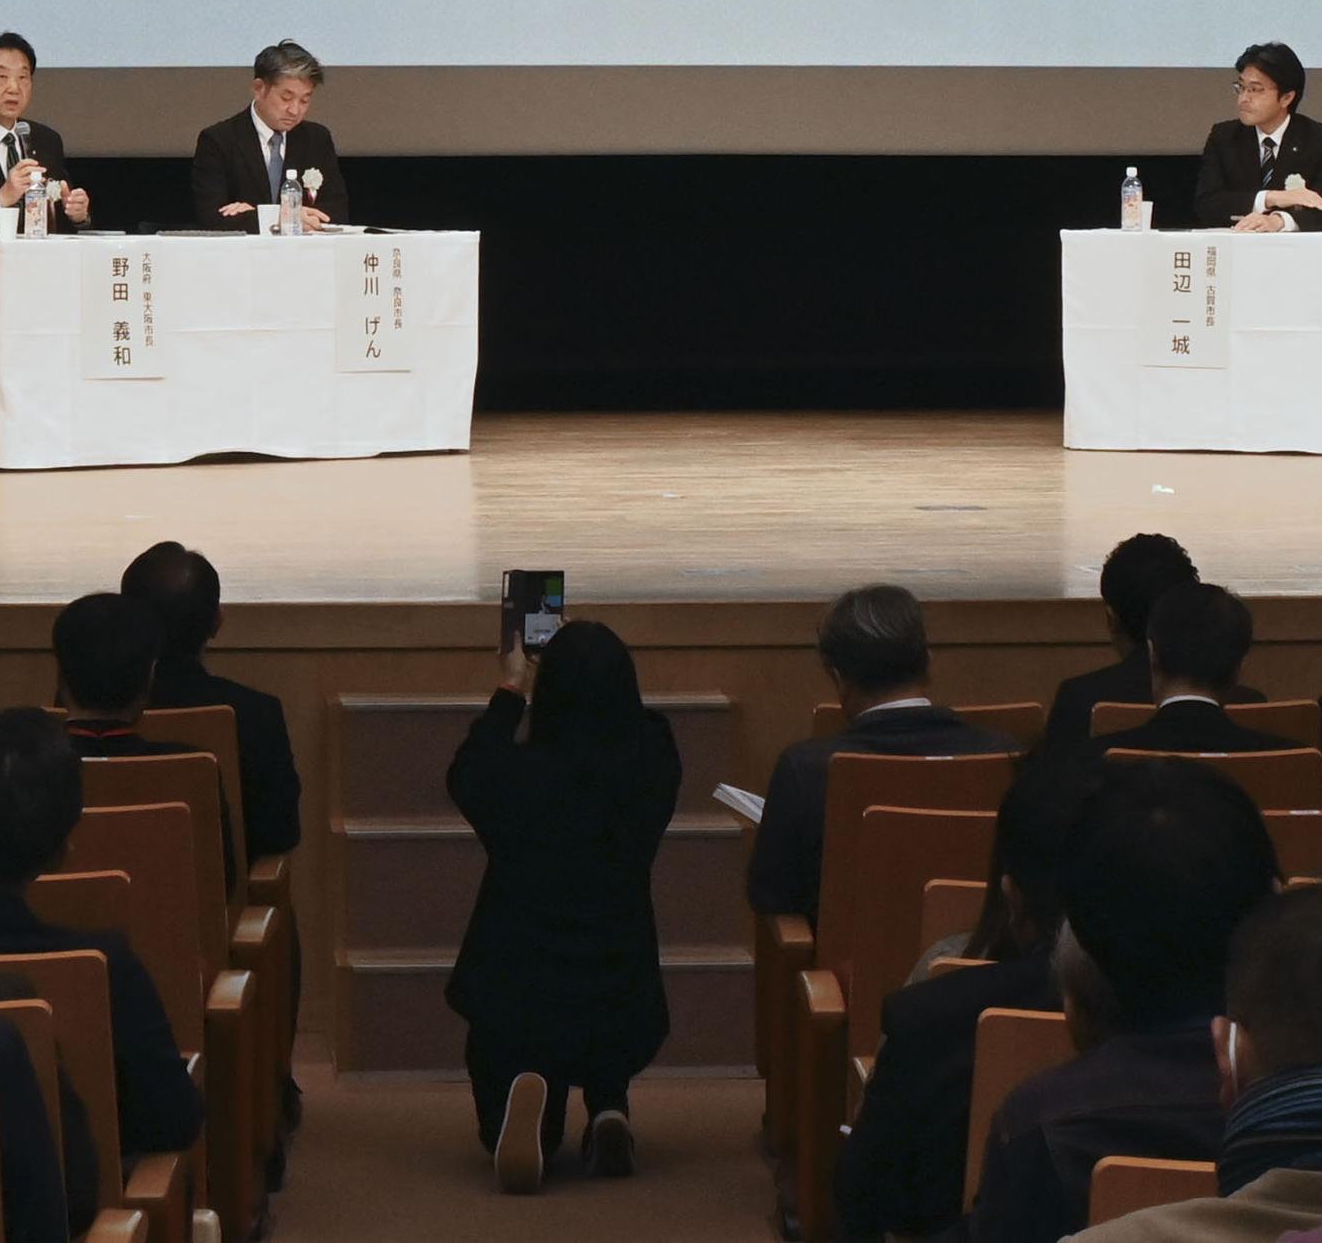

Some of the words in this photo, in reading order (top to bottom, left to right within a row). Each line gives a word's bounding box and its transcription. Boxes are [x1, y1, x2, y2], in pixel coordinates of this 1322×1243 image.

[112, 257, 130, 302] 野田
[141, 252, 152, 285] 大阪府
[362, 253, 379, 296] 仲川
[1172, 251, 1192, 293] 田辺
[1205, 246, 1217, 278] 福岡県
[142, 291, 154, 347] 東大阪市長
[365, 316, 382, 359] げん
[1171, 319, 1191, 355] 一城
[112, 320, 132, 366] 義和
